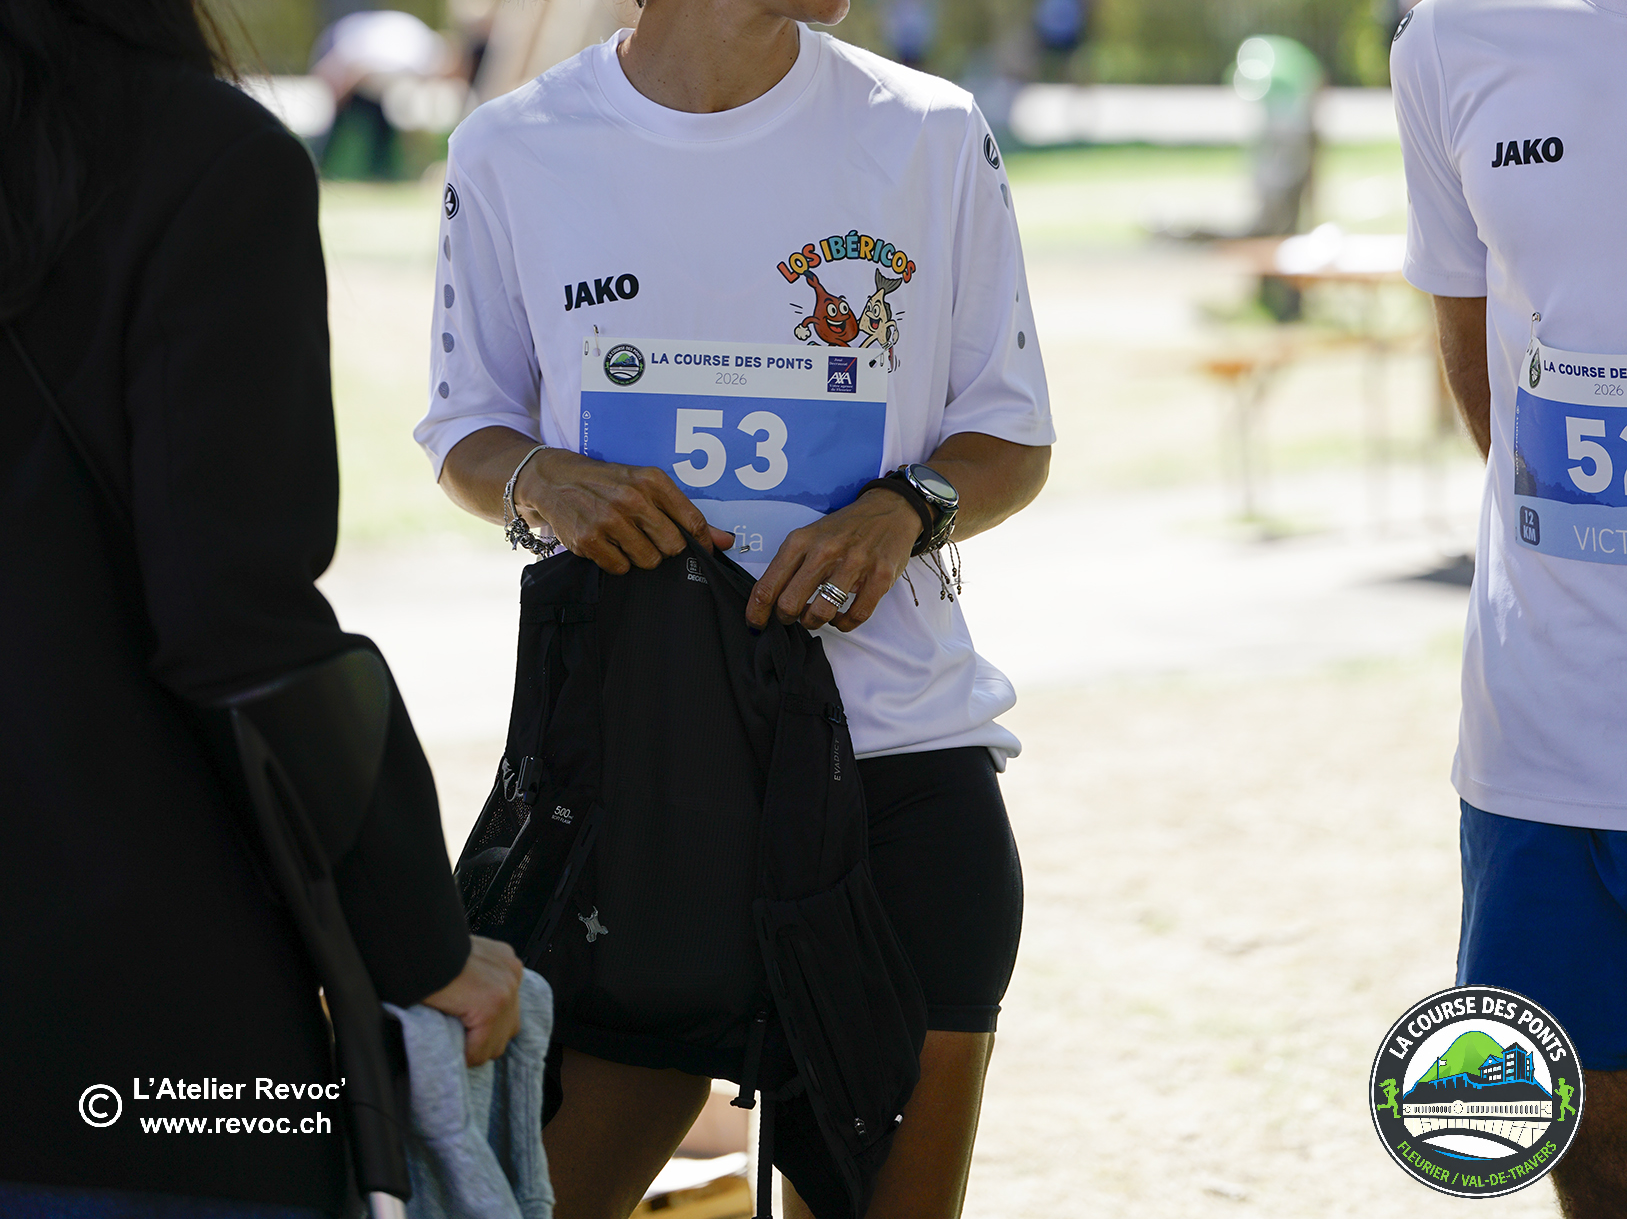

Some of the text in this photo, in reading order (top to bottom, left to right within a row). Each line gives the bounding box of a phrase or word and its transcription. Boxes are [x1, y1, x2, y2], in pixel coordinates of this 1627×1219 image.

[1491, 137, 1564, 168] JAKO
[777, 229, 916, 284] LOS IBÉRICOS
[564, 273, 640, 311] JAKO
[651, 352, 813, 370] LA COURSE DES PONTS
[1543, 359, 1556, 374] LA
[1559, 363, 1606, 379] COURSE
[715, 372, 748, 386] 2026
[827, 372, 852, 385] AXA
[1594, 383, 1624, 397] 2026
[672, 407, 789, 491] 53
[1565, 416, 1627, 496] 5
[1524, 509, 1534, 525] 12
[732, 525, 763, 551] fia
[1523, 524, 1536, 542] KM
[1573, 525, 1627, 555] VICT
[833, 738, 841, 782] EVADICT
